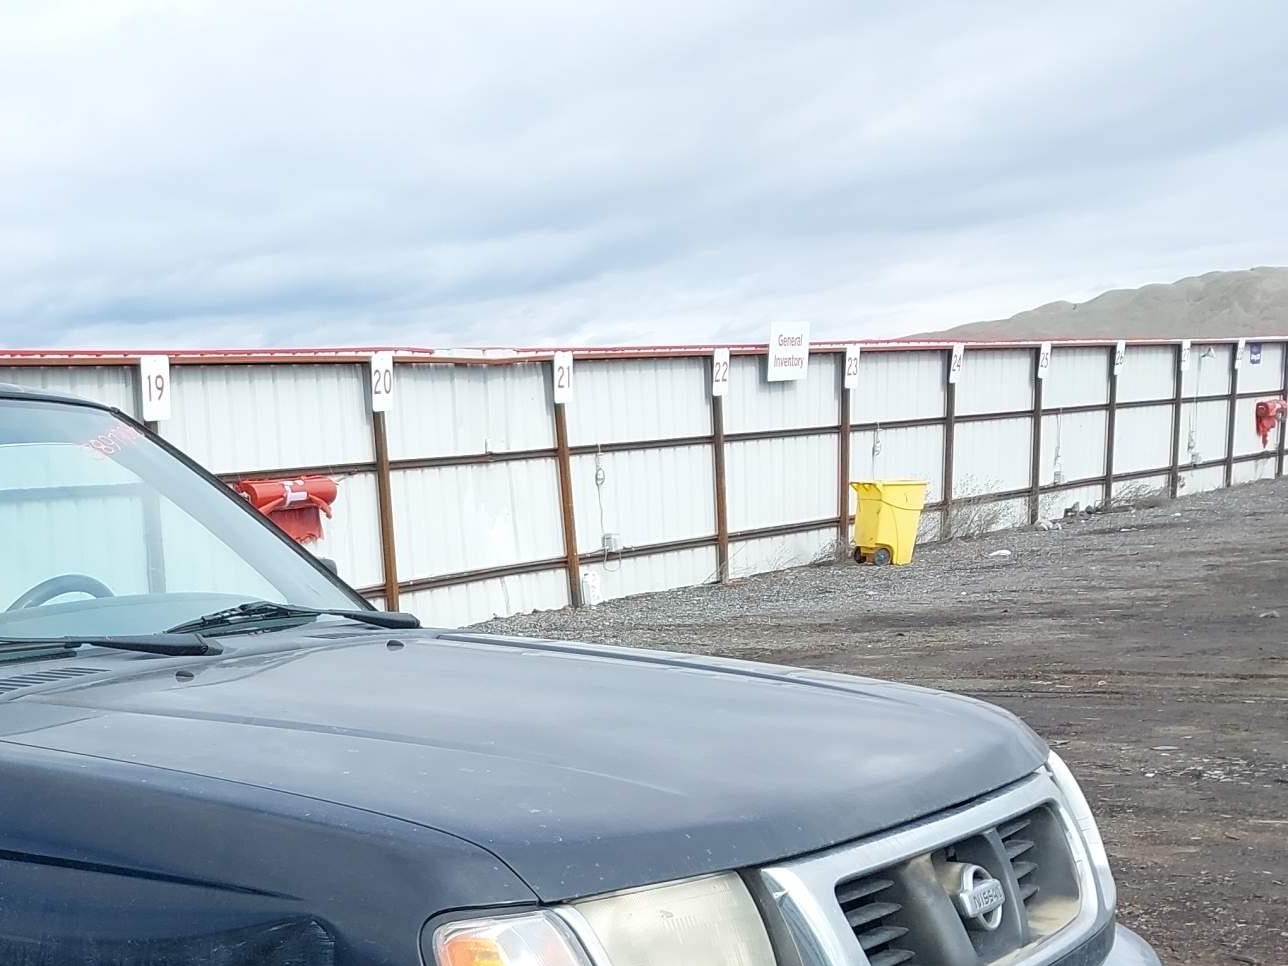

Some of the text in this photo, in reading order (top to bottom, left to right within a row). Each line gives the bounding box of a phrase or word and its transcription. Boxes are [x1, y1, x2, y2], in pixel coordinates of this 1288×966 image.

[778, 334, 803, 346] General
[773, 354, 804, 369] Inventory
[847, 357, 858, 376] 23
[952, 353, 962, 372] 24
[1040, 352, 1049, 368] 25
[557, 365, 570, 388] 21
[714, 362, 728, 382] 22
[147, 374, 165, 402] 19
[373, 369, 392, 395] 20
[973, 887, 1003, 910] NISSAN
